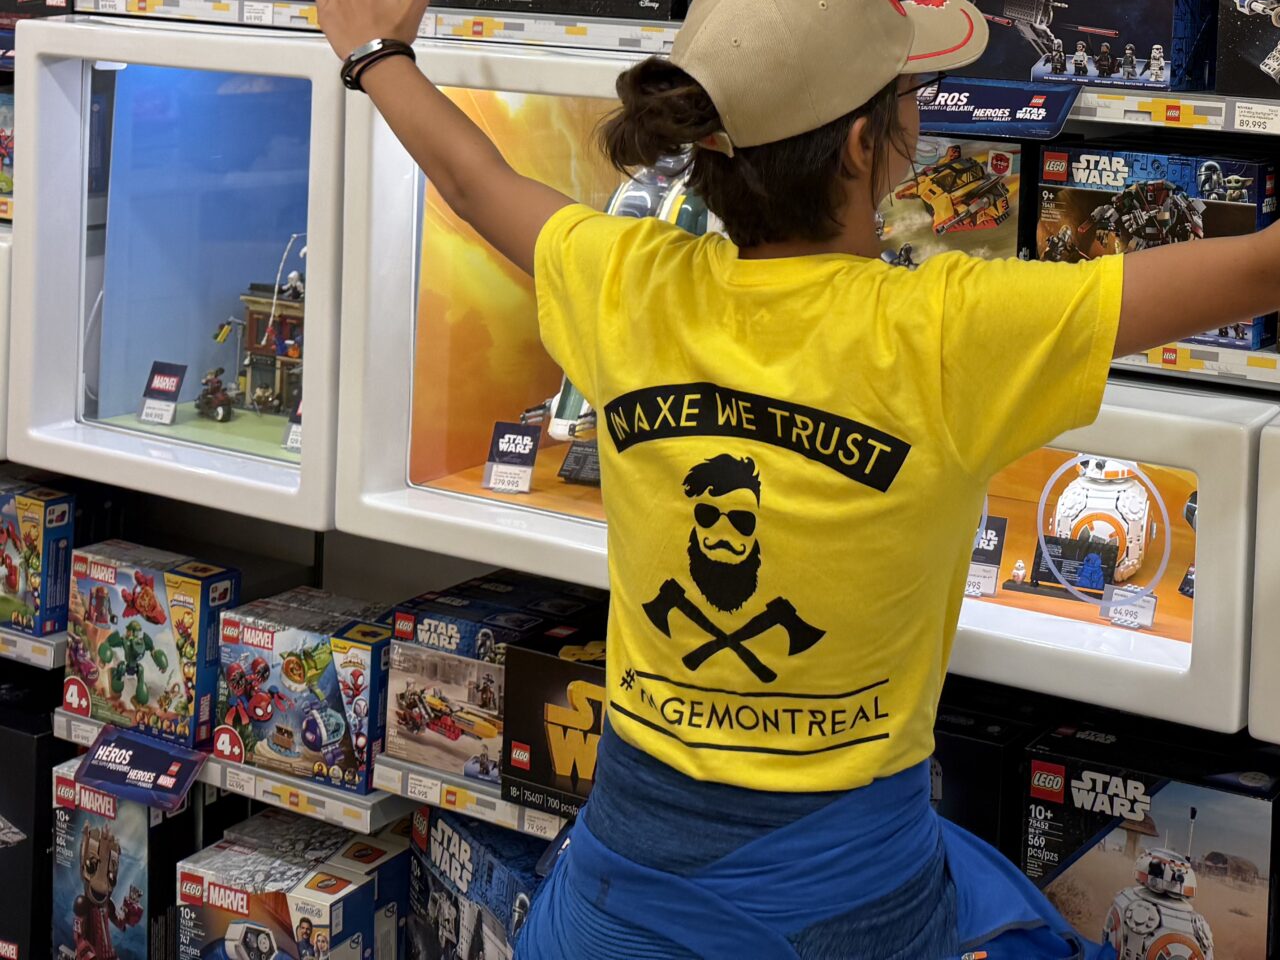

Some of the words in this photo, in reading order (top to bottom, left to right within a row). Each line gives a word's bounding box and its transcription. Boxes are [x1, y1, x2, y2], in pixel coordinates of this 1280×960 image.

[1045, 159, 1066, 172] LEGO
[1042, 191, 1054, 201] 9+
[499, 434, 533, 445] STAR
[610, 411, 631, 441] IN
[633, 394, 702, 433] AXE
[716, 393, 758, 431] WE
[767, 407, 892, 475] TRUST
[499, 443, 533, 454] WARS
[90, 564, 116, 584] MARVEL
[417, 618, 460, 637] STAR
[244, 627, 273, 648] MARVEL
[417, 629, 460, 650] WARS
[65, 685, 88, 708] 4+
[95, 743, 133, 765] HÉROS
[216, 734, 241, 756] 4+
[1032, 771, 1064, 790] LEGO
[57, 785, 74, 800] LEGO
[81, 792, 116, 818] MARVEL
[56, 810, 70, 822] 10+
[1028, 834, 1046, 848] 569
[182, 882, 201, 896] LEGO
[209, 886, 249, 914] MARVEL
[180, 907, 196, 919] 10+
